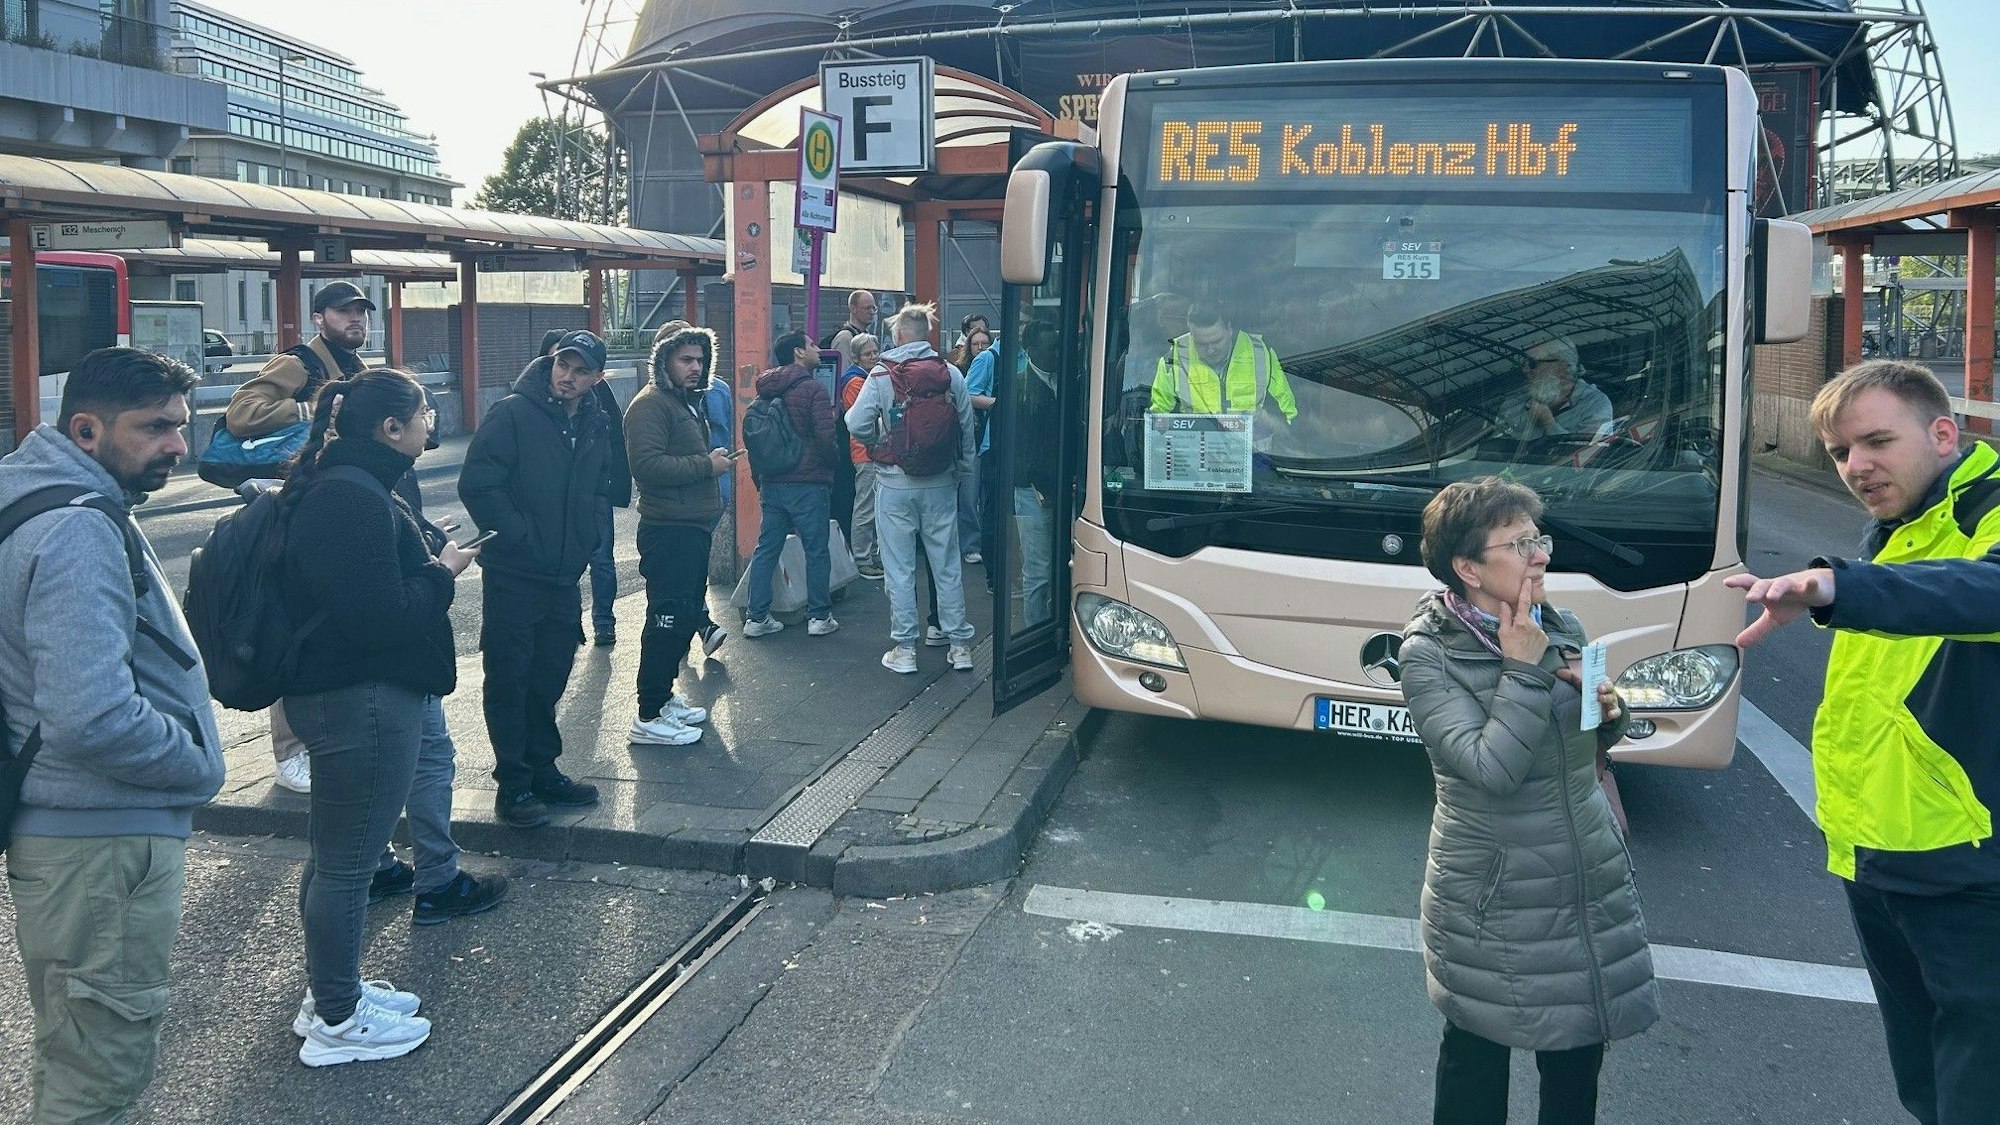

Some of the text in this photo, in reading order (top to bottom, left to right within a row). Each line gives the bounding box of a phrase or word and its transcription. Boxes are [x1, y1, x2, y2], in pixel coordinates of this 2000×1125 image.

[838, 69, 906, 90] Bussteig
[1059, 94, 1101, 121] SPE
[852, 94, 893, 162] F
[813, 133, 827, 169] H
[1160, 121, 1578, 181] RE5 Koblenz Hbf
[36, 232, 46, 247] E
[61, 224, 127, 236] 132 Meschenich
[325, 245, 336, 262] E
[1401, 242, 1422, 251] SEV
[1393, 262, 1432, 279] 515
[1172, 420, 1240, 430] SEV RE5
[1331, 704, 1413, 733] HER KA
